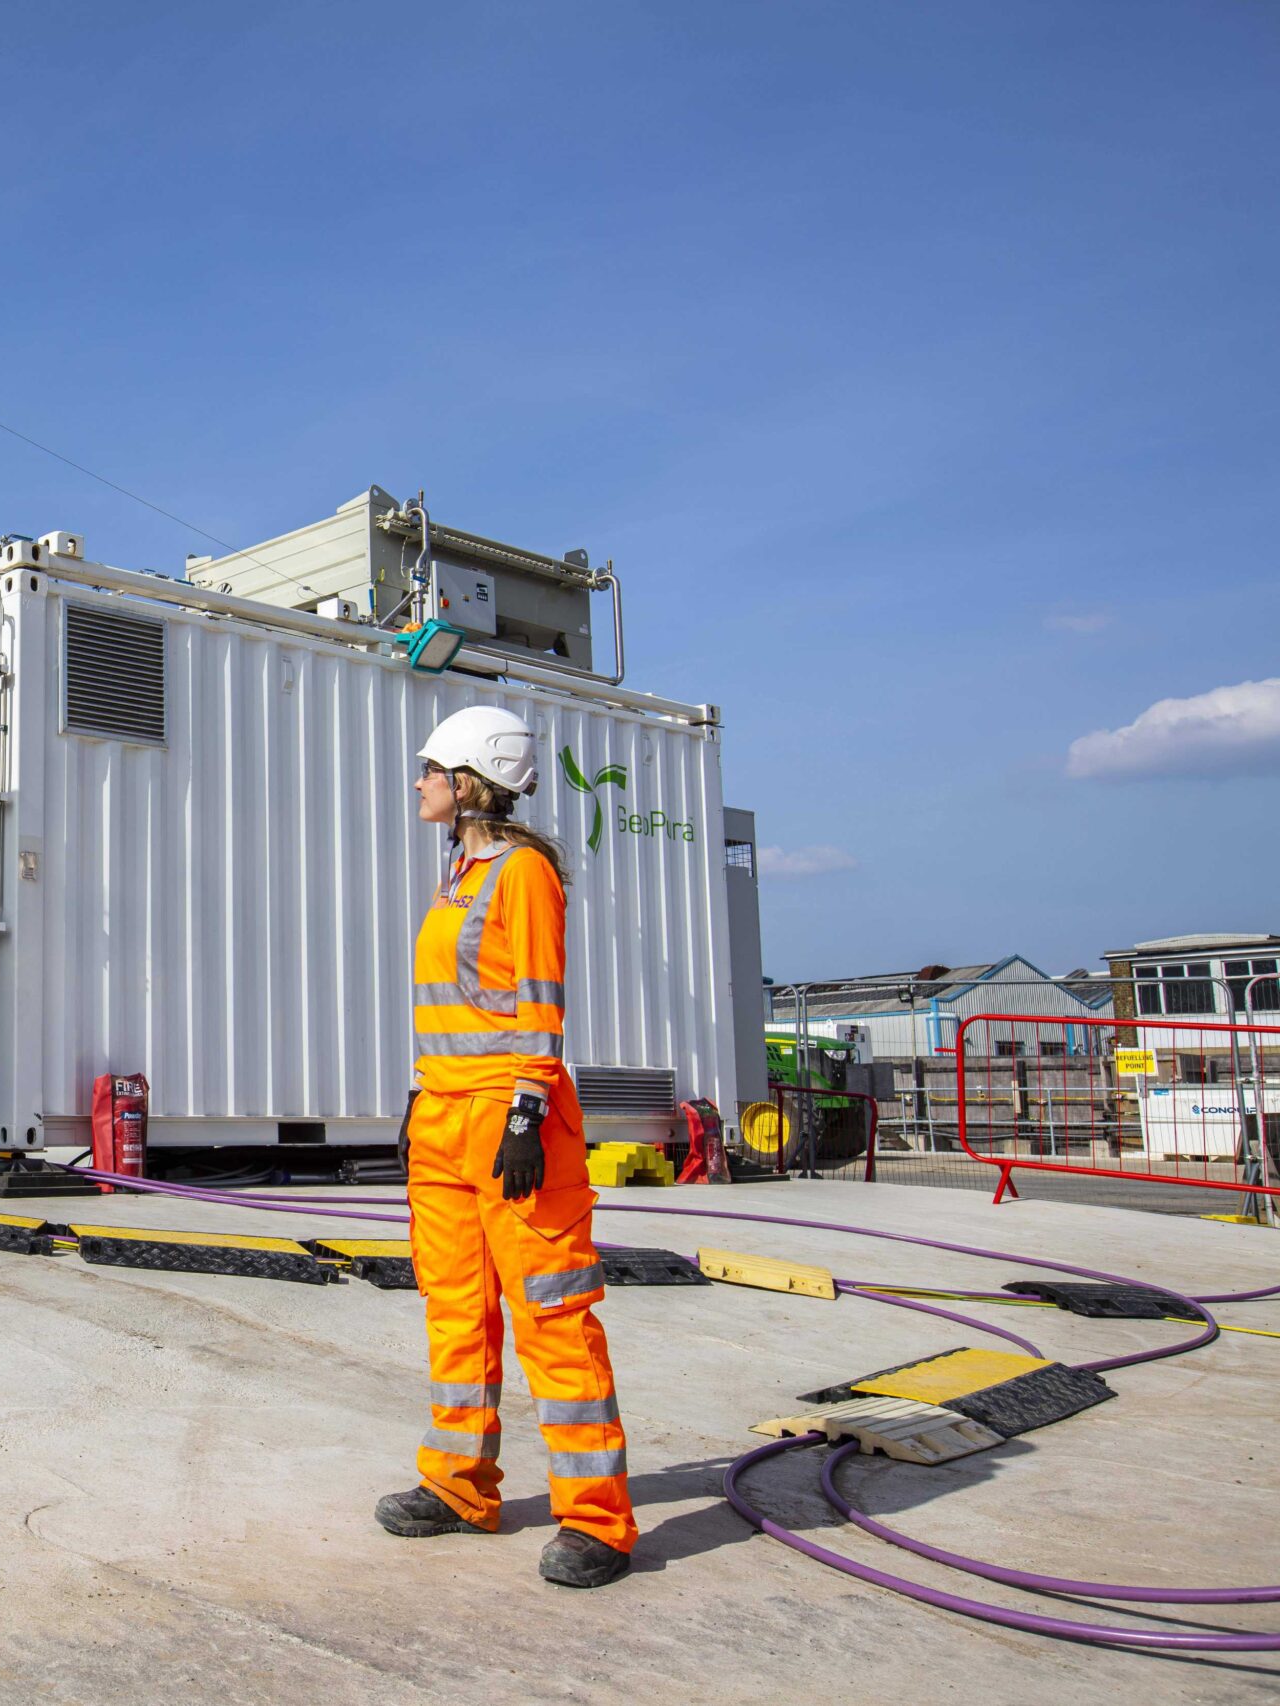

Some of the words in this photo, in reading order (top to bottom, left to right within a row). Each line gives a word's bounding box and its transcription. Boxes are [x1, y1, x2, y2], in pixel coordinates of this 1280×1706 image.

[451, 895, 474, 908] HS2
[116, 1080, 142, 1094] FIRE
[1201, 1106, 1257, 1114] CONQIP
